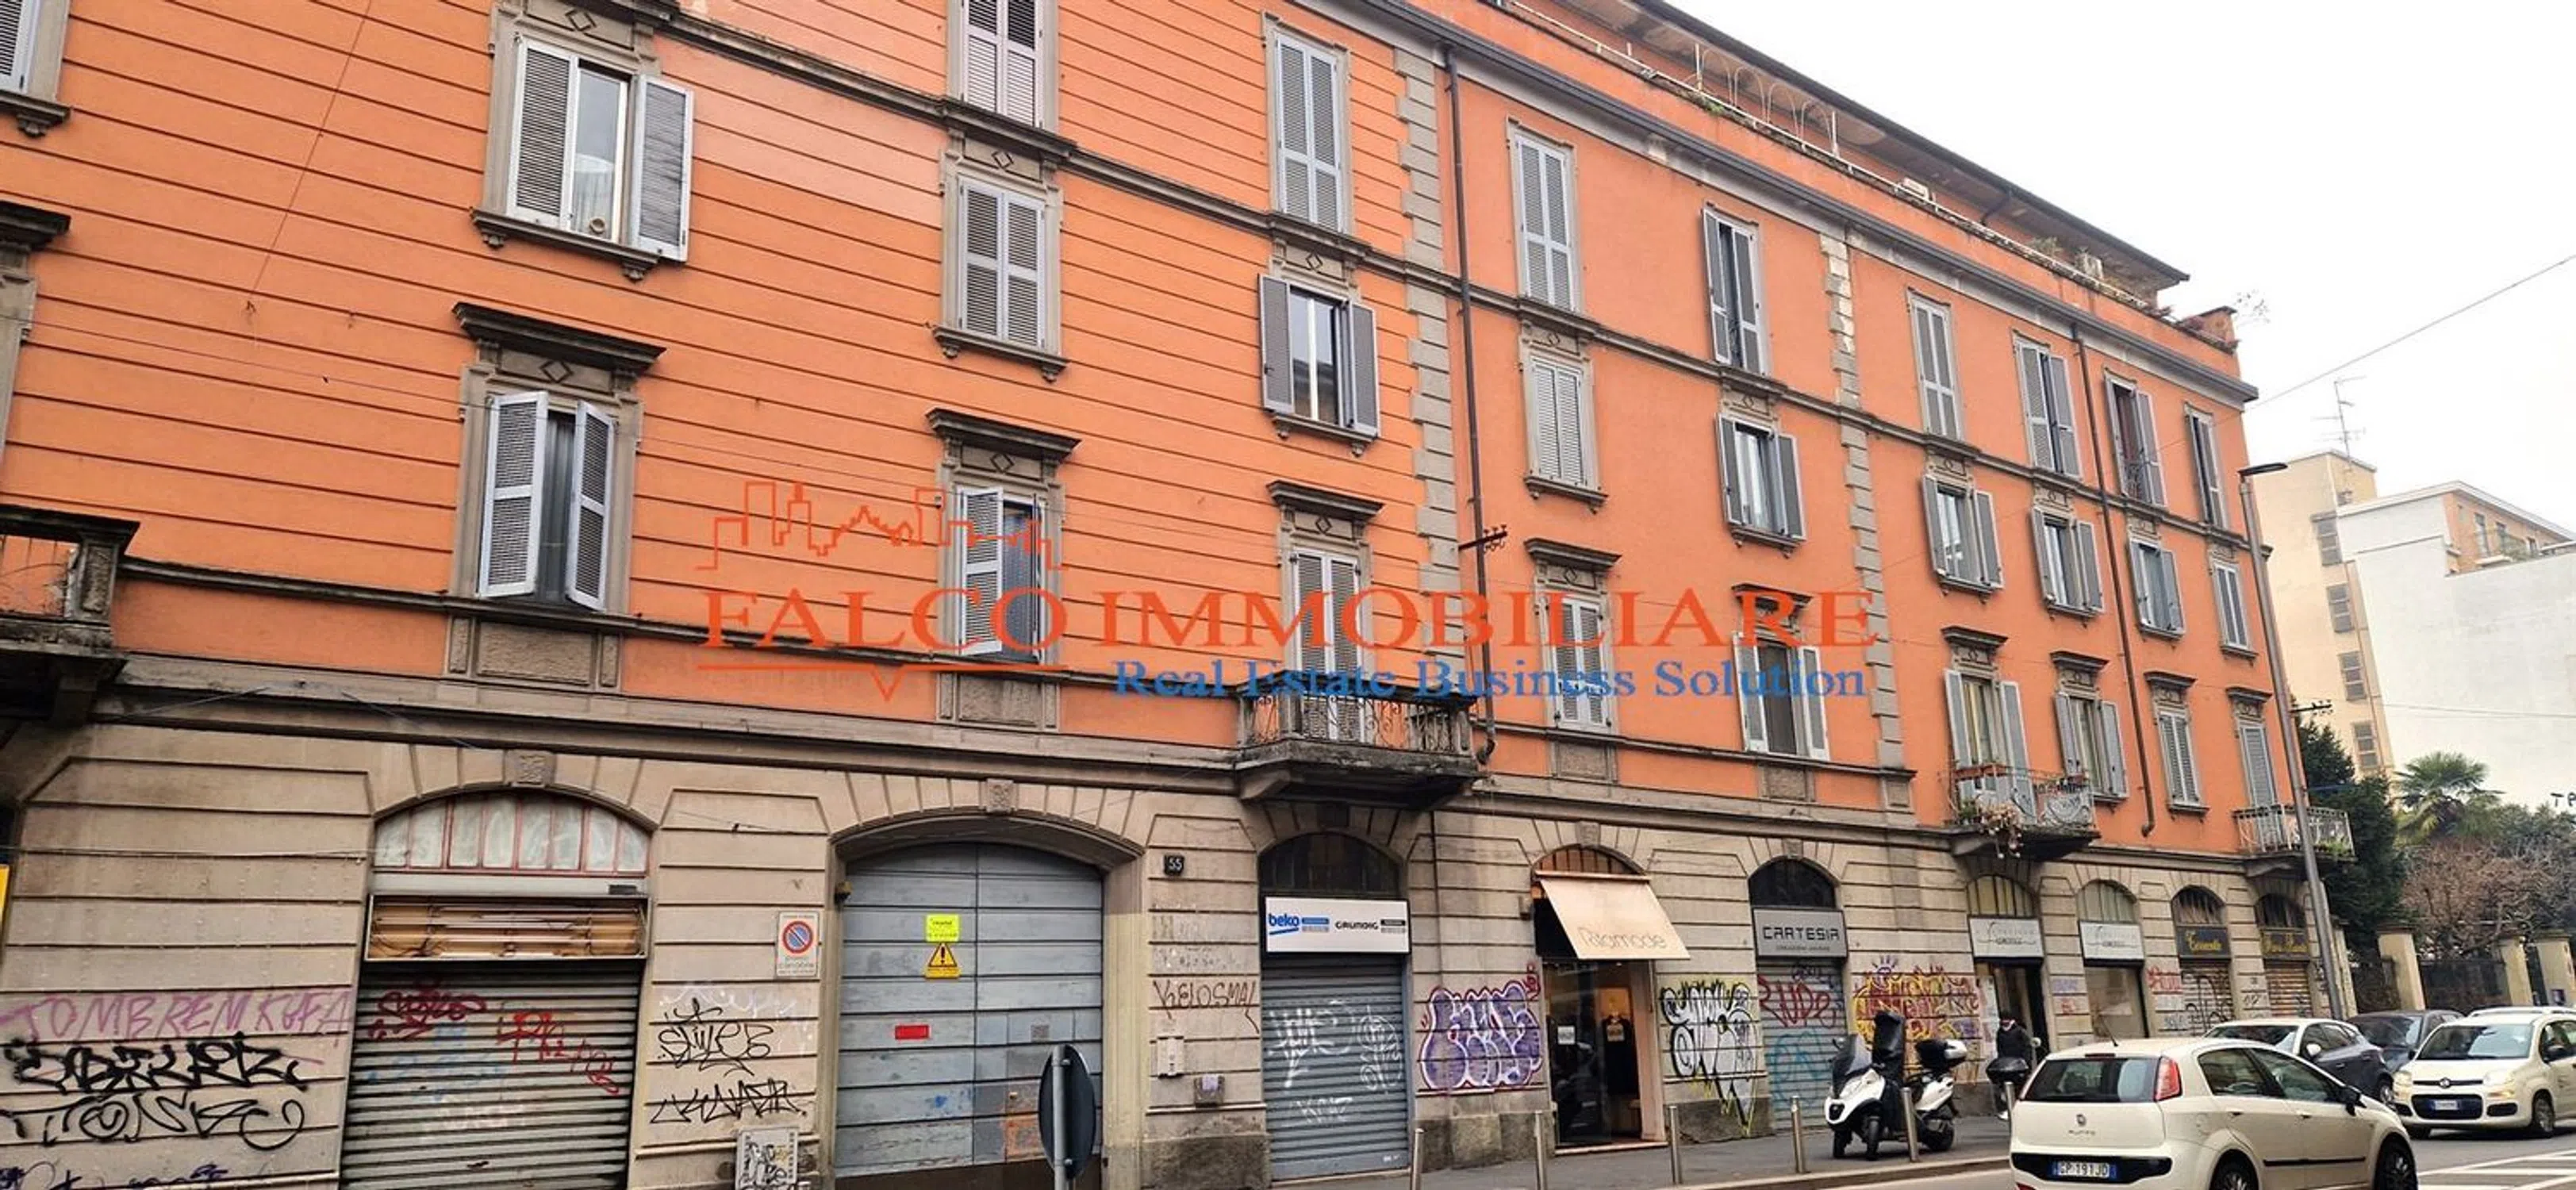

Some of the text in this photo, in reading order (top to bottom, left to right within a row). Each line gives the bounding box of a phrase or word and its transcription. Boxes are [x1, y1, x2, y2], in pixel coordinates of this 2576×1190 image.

[1169, 857, 1182, 870] 55
[1269, 913, 1300, 927] beko
[1335, 920, 1379, 930] GRUNDIG
[1763, 927, 1840, 940] CARTESIA
